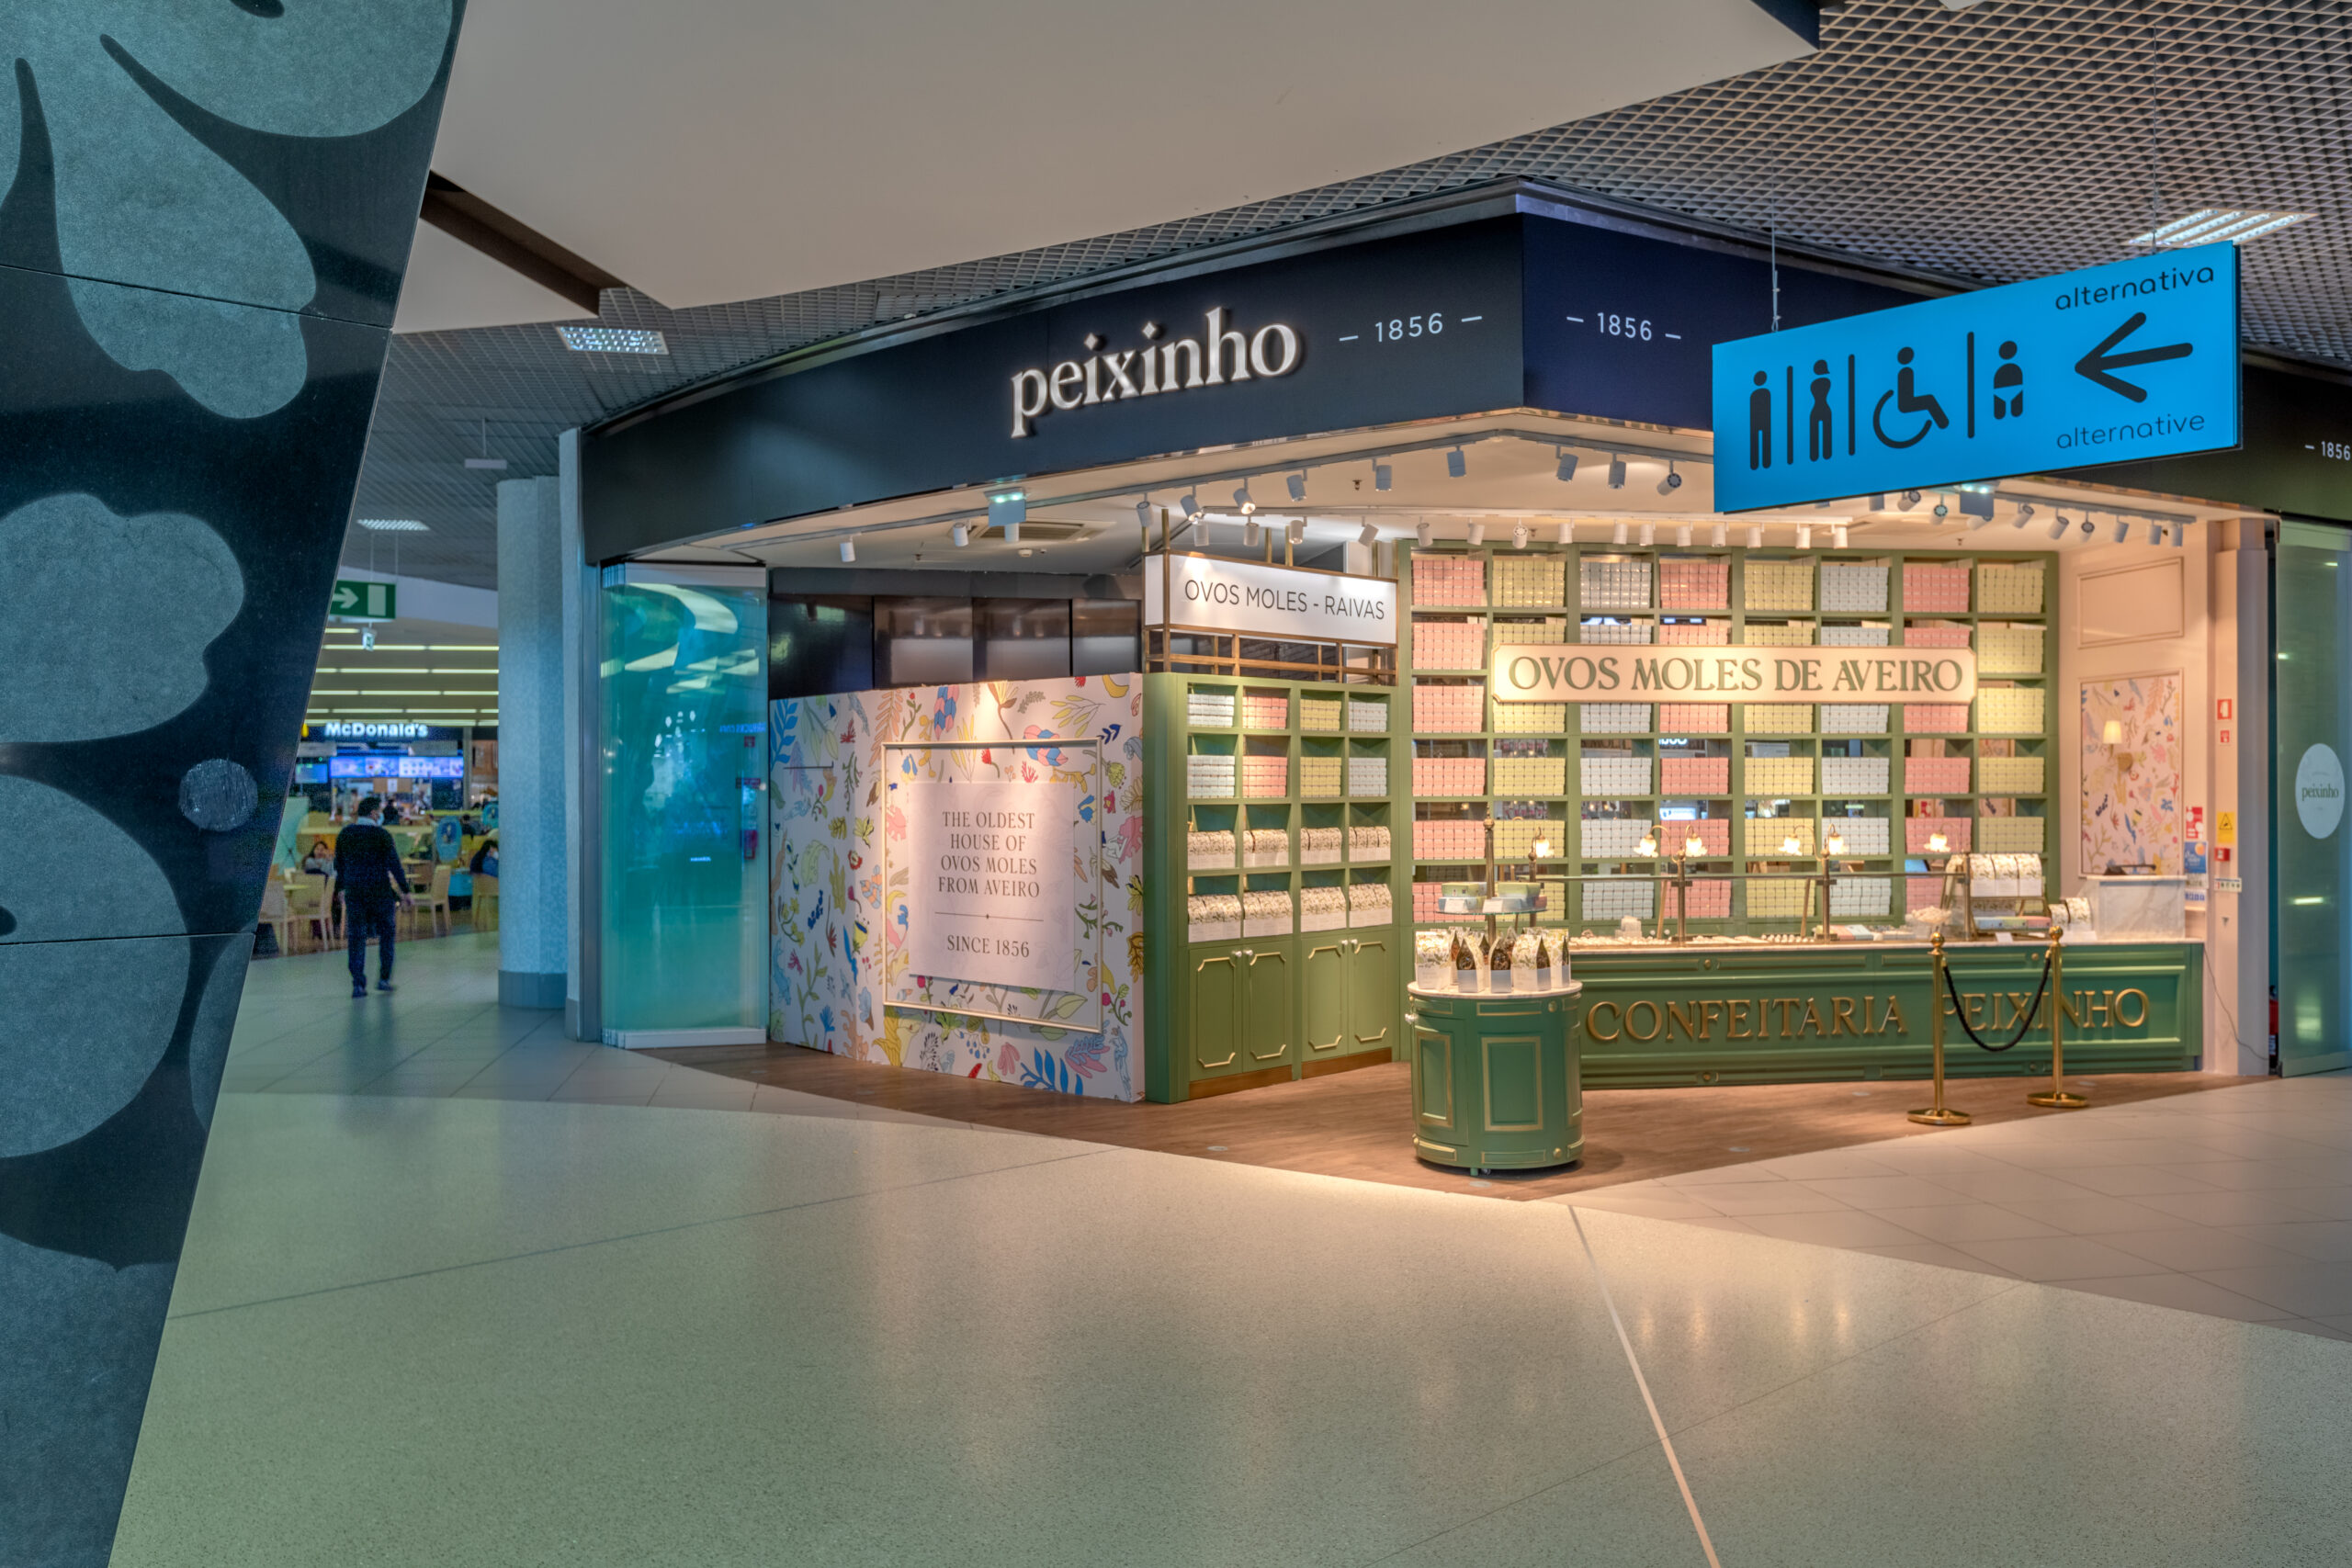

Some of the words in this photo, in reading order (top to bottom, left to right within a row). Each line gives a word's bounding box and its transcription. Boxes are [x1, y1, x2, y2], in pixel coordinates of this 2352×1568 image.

[2055, 266, 2214, 310] alternativa
[1011, 306, 1298, 438] peixinho
[2056, 413, 2205, 449] alternative
[1184, 579, 1239, 605] OVOS
[1246, 585, 1307, 613] MOLES
[1324, 594, 1385, 620] RAIVAS
[1509, 656, 1621, 690] OVOS
[1631, 657, 1763, 691] MOLES
[1773, 659, 1824, 691] DE
[1831, 659, 1963, 692] AVEIRO
[324, 722, 429, 738] McDonald's
[2301, 783, 2339, 802] peixinho
[942, 811, 971, 828] THE
[976, 811, 1035, 829] OLDEST
[950, 833, 1001, 851] HOUSE
[1005, 834, 1027, 852] OF
[941, 854, 980, 873] OVOS
[985, 857, 1037, 875] MOLES
[938, 876, 978, 895] FROM
[984, 879, 1040, 898] AVEIRO
[947, 934, 990, 954] SINCE
[996, 939, 1030, 958] 1856
[1586, 995, 1909, 1042] CONFEITARIA
